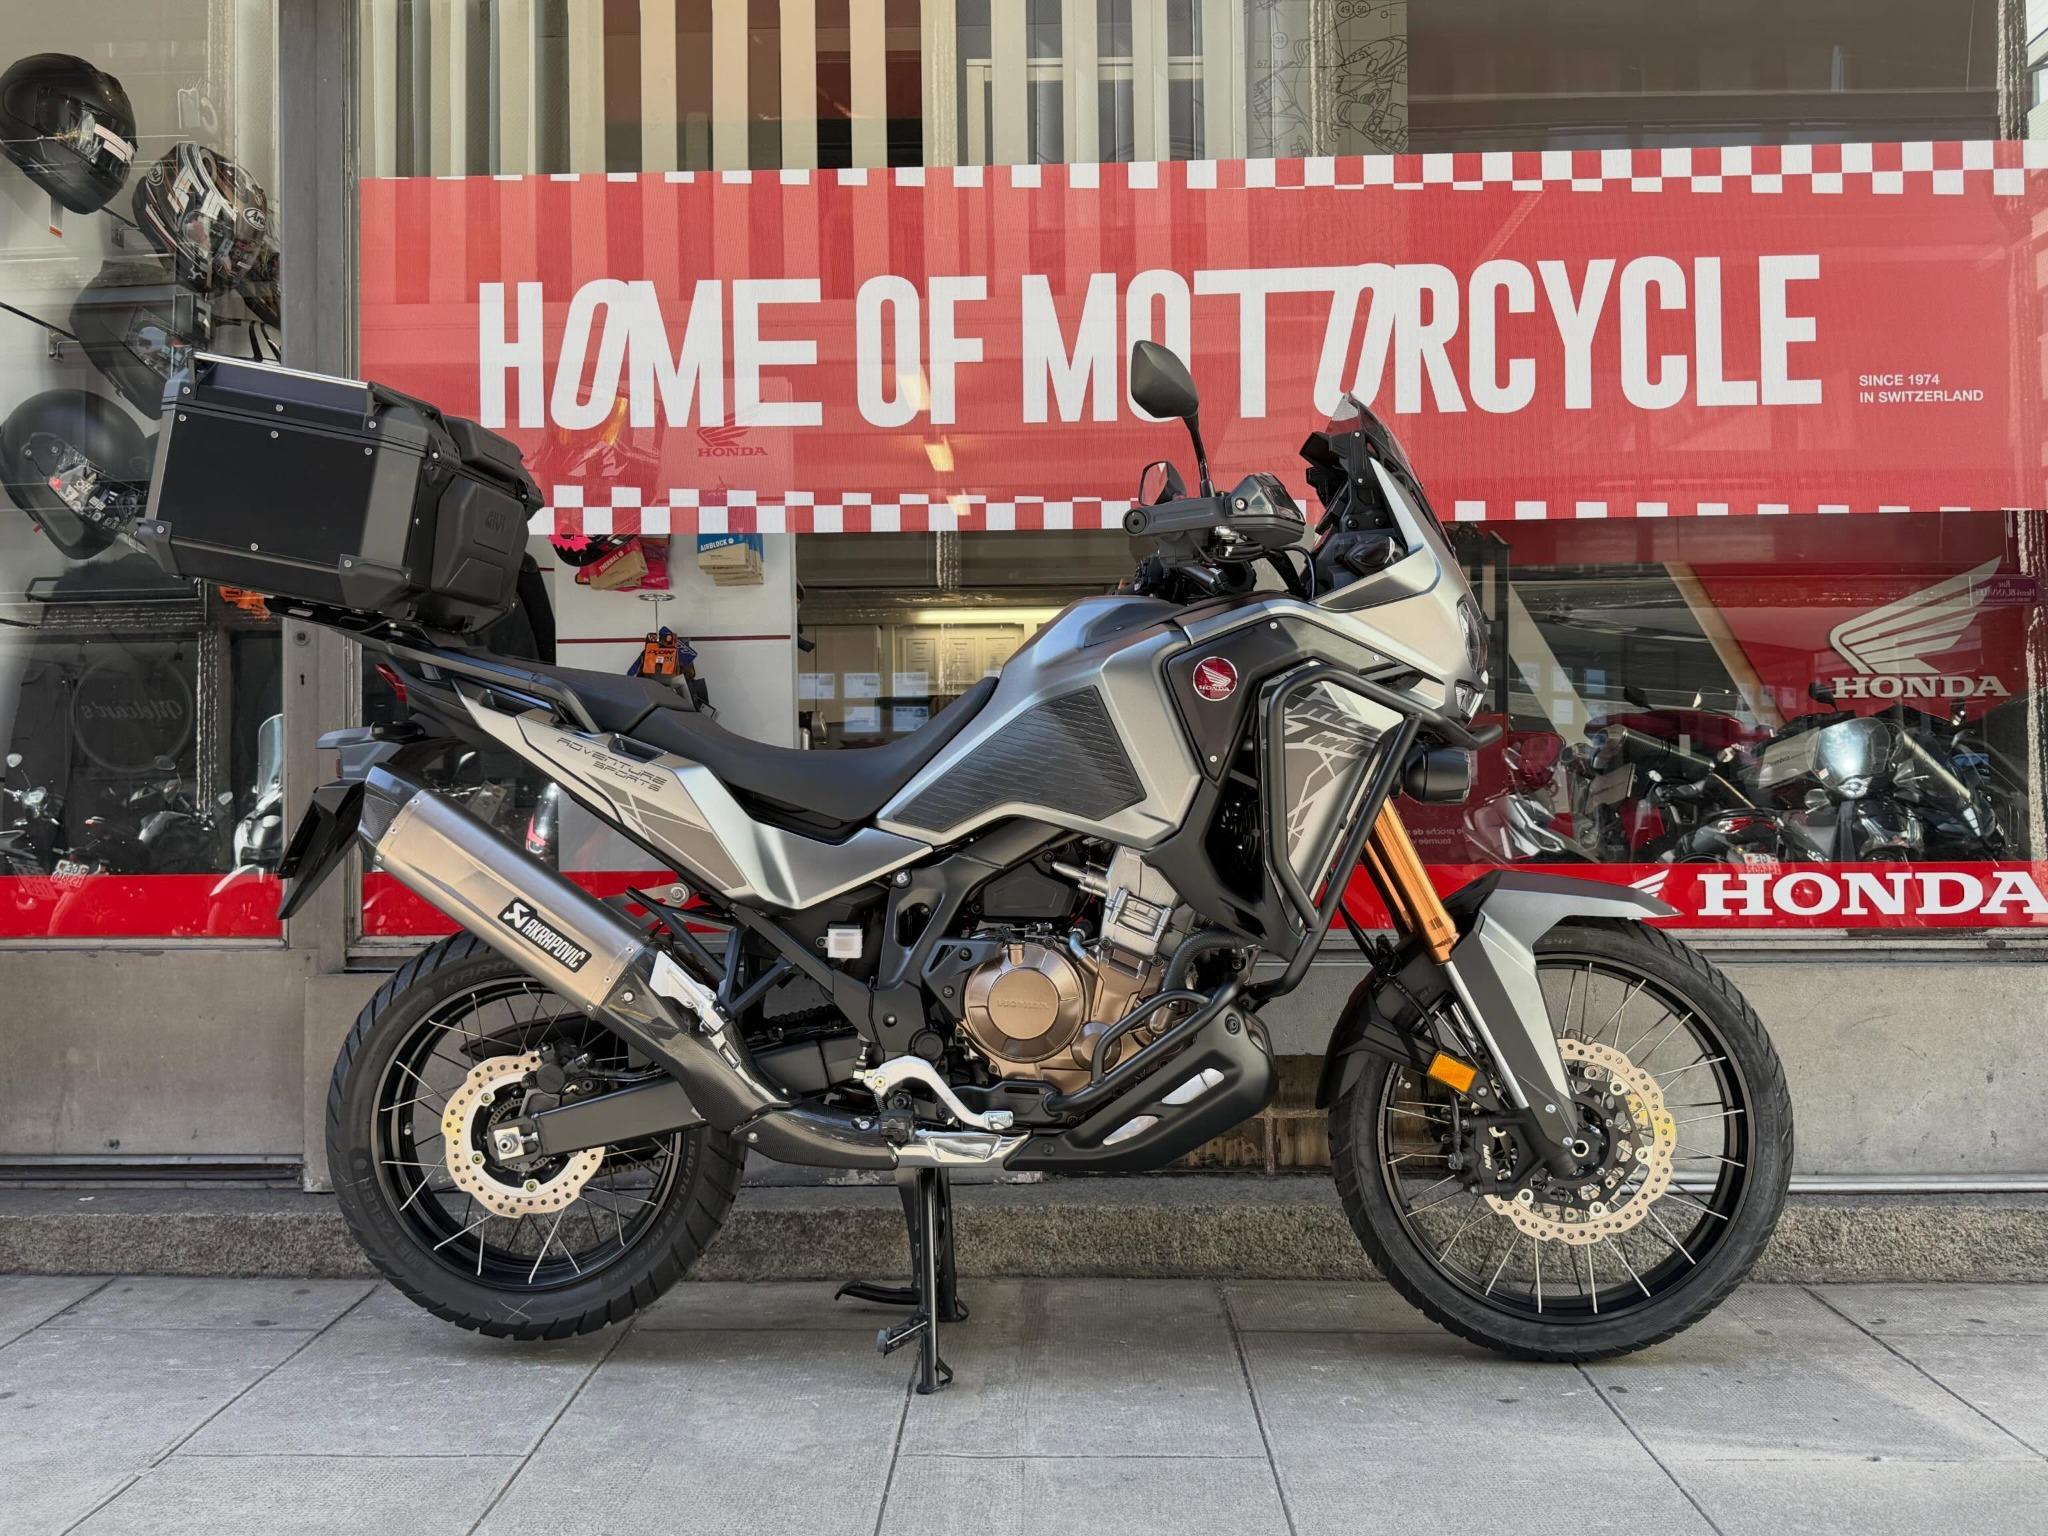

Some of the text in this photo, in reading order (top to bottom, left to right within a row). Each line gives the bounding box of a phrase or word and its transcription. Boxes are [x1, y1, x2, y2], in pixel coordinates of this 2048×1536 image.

[478, 254, 1823, 430] HOME OF MOTORCYCLE
[1859, 373, 1941, 387] SINCE 1974
[1859, 389, 1984, 403] IN SWITZERLAND
[697, 446, 769, 457] HONDA
[1198, 684, 1231, 693] HONDA
[1832, 675, 2012, 699] HONDA
[556, 737, 668, 786] ADVENTURE
[593, 760, 662, 793] SPORTS
[1697, 871, 2048, 917] HONDA
[521, 918, 586, 969] AKRAPOVIČ
[996, 999, 1050, 1010] HONDA
